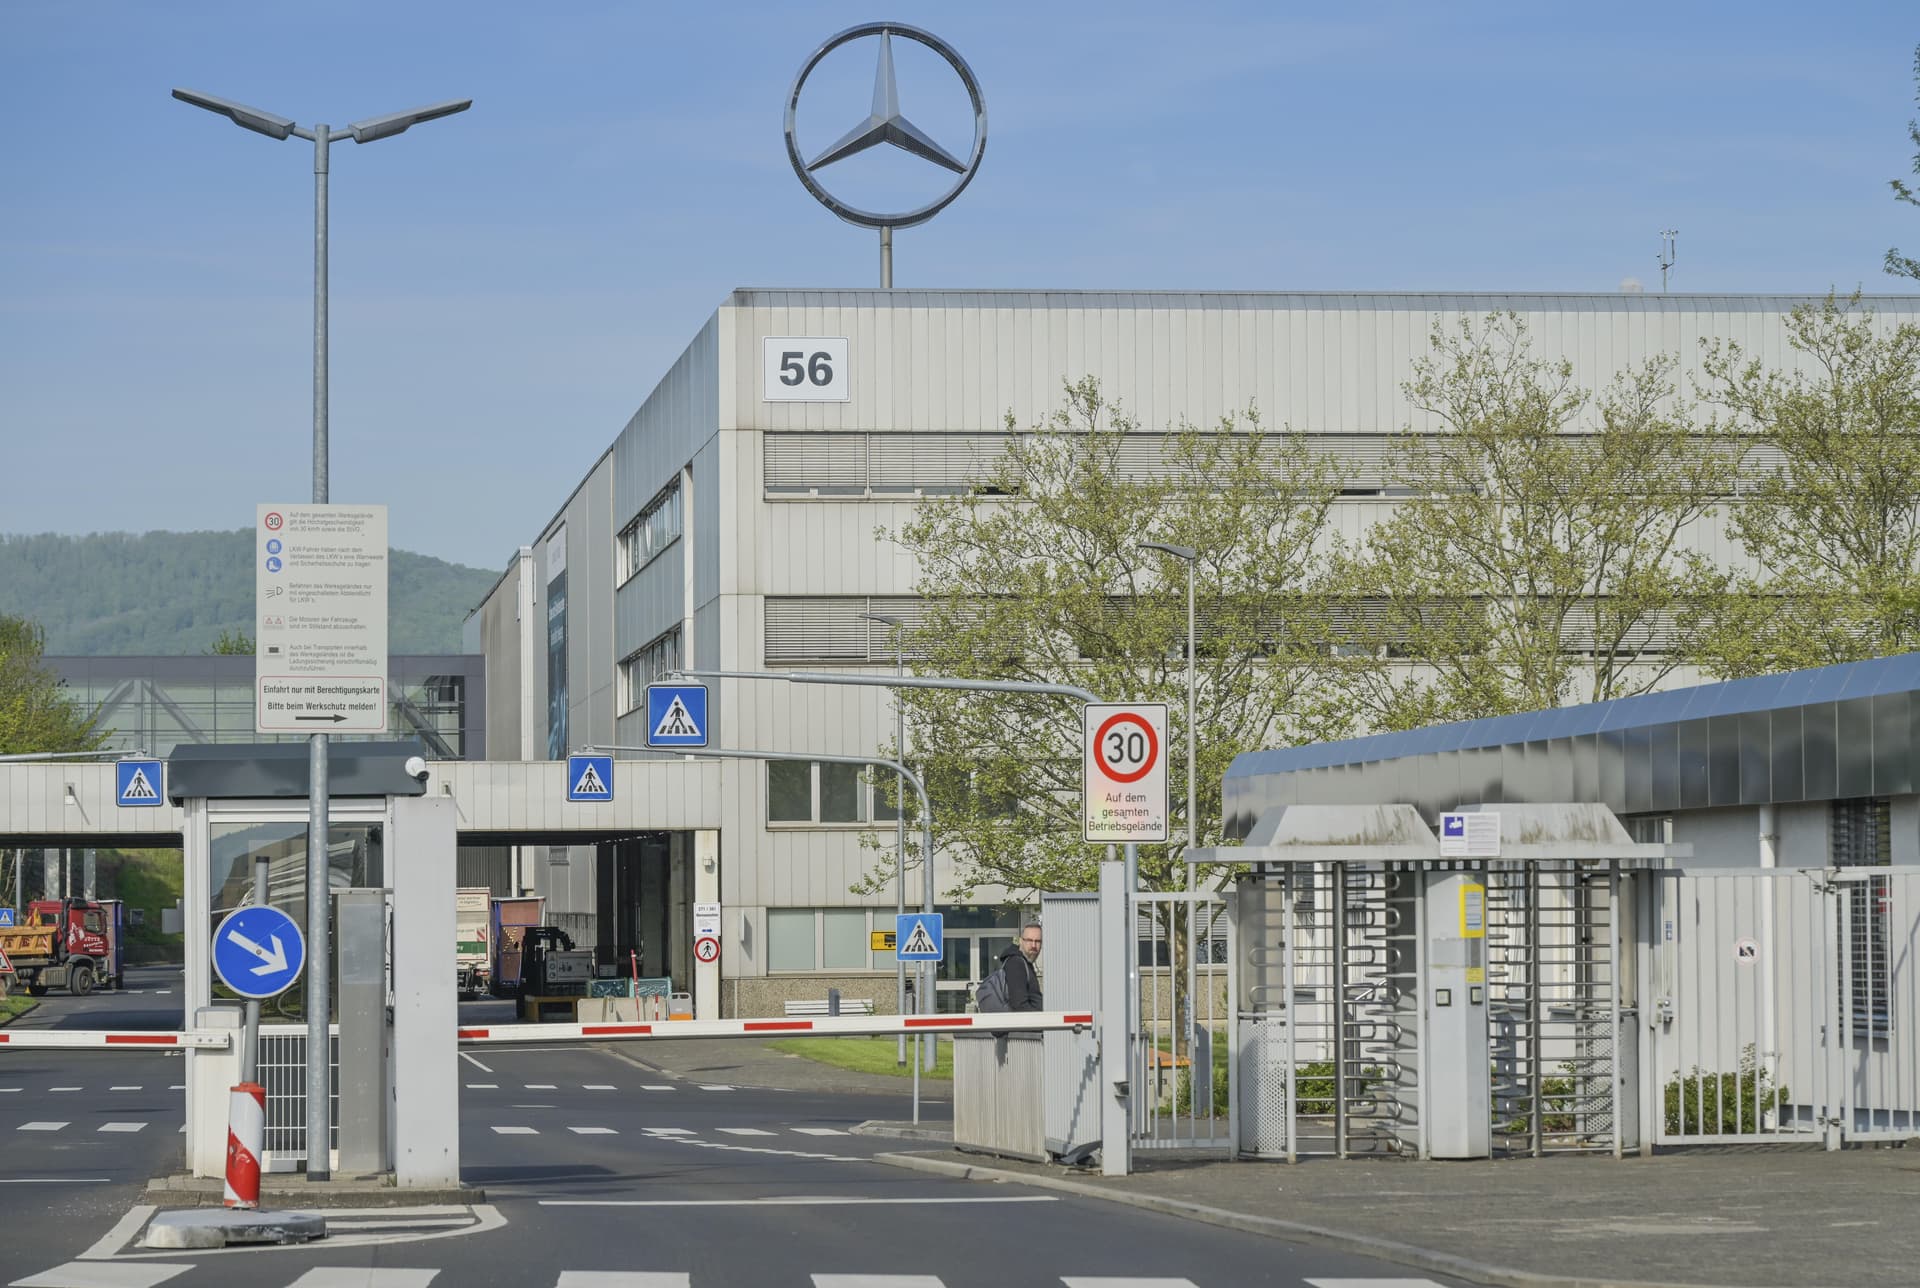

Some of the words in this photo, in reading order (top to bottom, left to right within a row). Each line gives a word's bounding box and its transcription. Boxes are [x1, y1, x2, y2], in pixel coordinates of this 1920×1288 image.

[779, 351, 833, 387] 56
[269, 517, 280, 526] 30
[264, 685, 290, 694] Einfahrt
[304, 685, 315, 694] mit
[317, 685, 380, 696] Berechtigungskarte
[267, 702, 284, 710] Bitte
[286, 702, 304, 710] beim
[306, 702, 346, 710] Werkschutz
[348, 702, 376, 710] melden!
[1107, 732, 1144, 764] 30
[1105, 792, 1122, 802] Auf
[1124, 792, 1146, 802] dem
[1102, 808, 1150, 819] gesamten
[1088, 820, 1162, 834] Betriebsgelände
